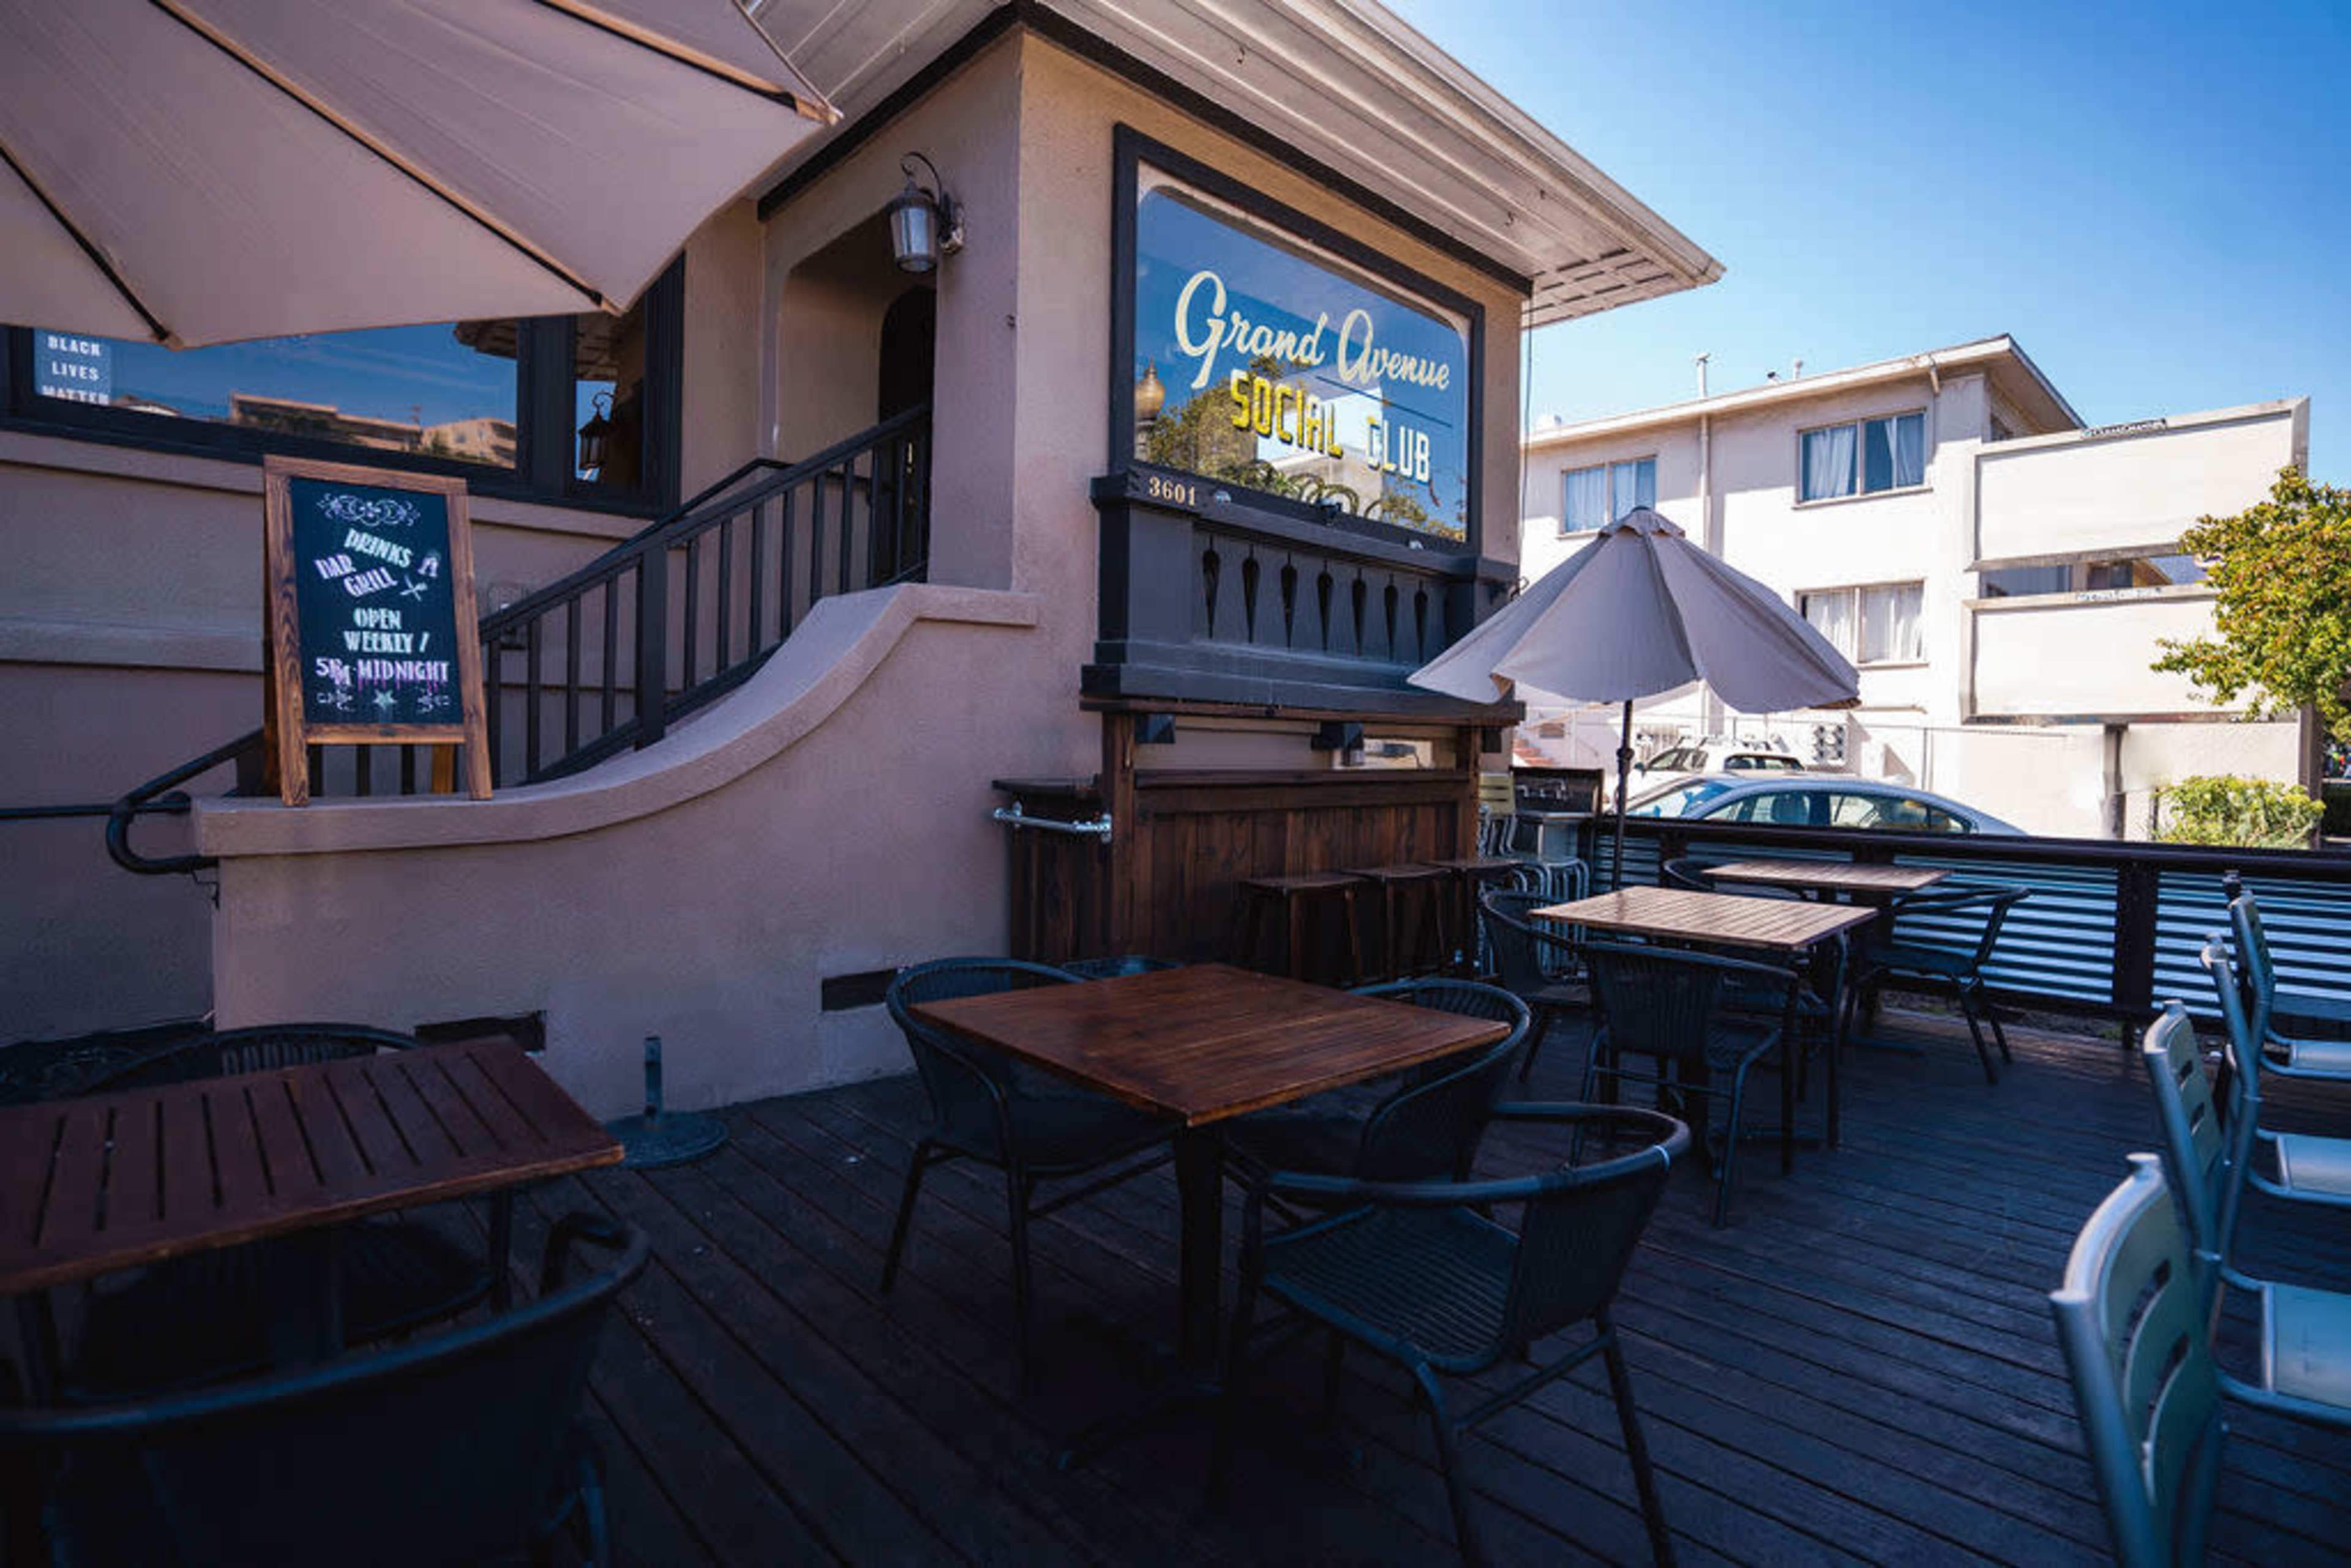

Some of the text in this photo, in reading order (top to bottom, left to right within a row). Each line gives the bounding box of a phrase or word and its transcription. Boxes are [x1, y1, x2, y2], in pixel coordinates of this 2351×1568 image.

[47, 334, 101, 357] BLACK
[1175, 270, 1450, 391] Grand Avenue
[51, 361, 99, 382] LIVES
[1229, 369, 1431, 484] SOCIAL CLUB
[1149, 476, 1196, 506] 3601
[343, 528, 413, 569] DRINKS
[343, 566, 399, 598] GRILL
[353, 607, 402, 629] OPEN
[343, 631, 414, 654] WEEKLY
